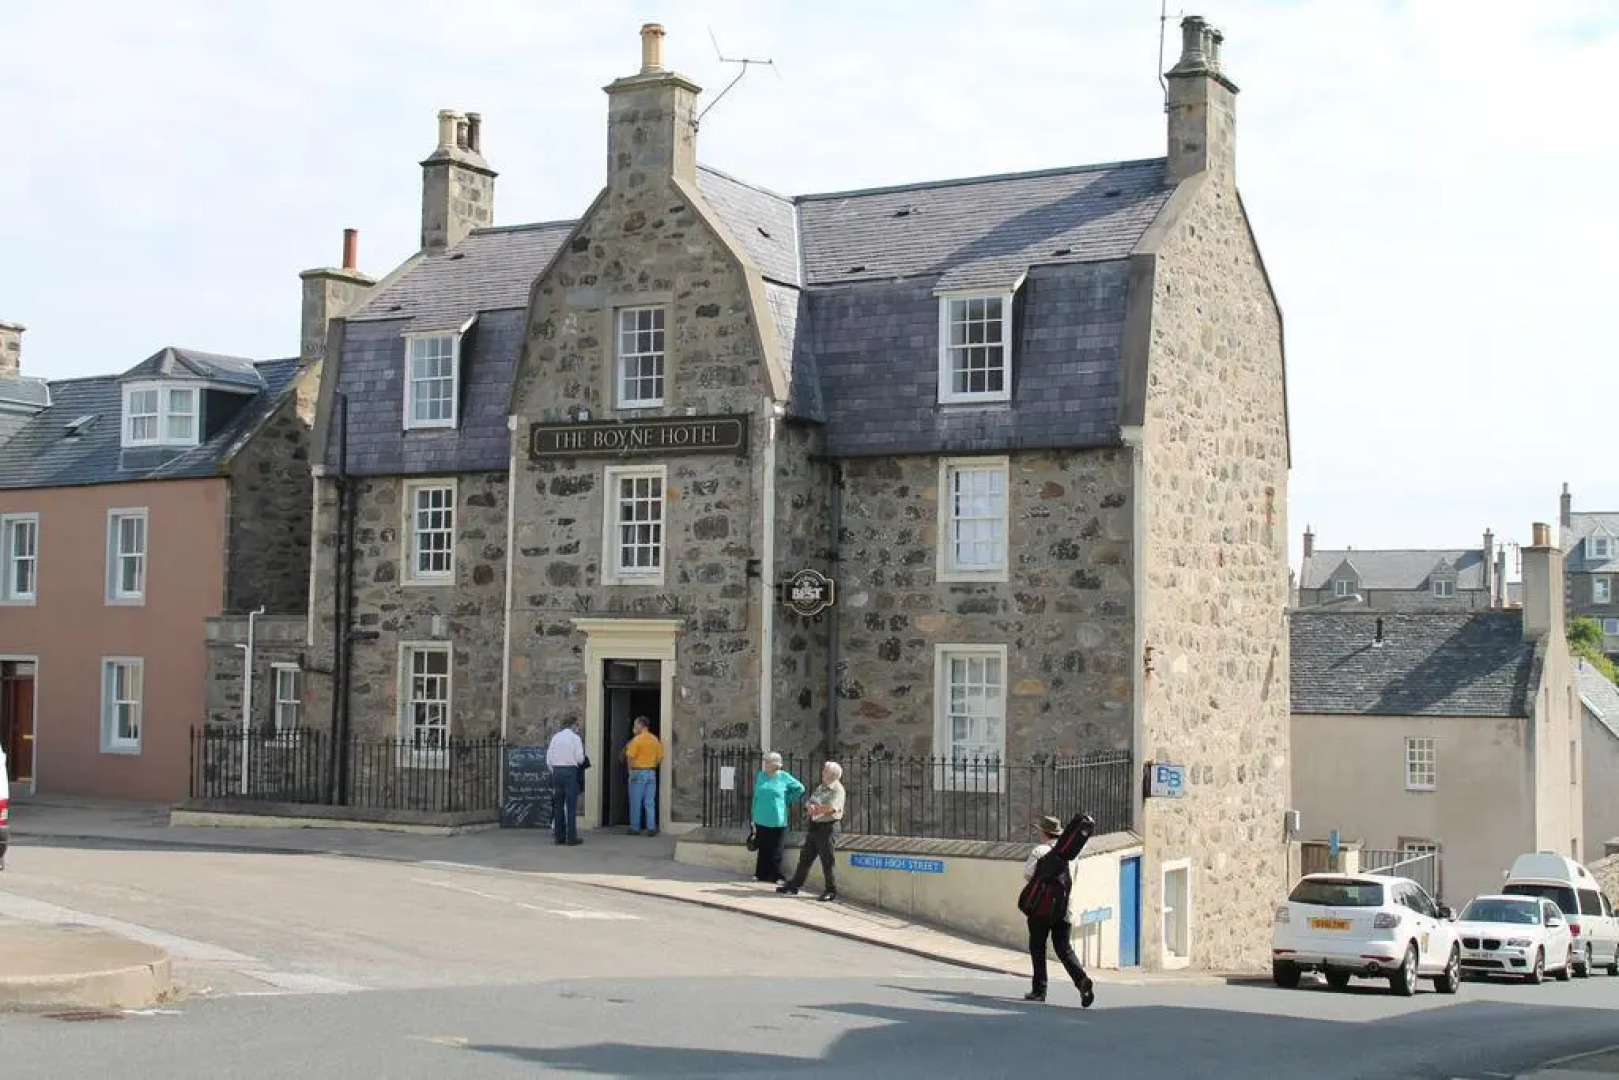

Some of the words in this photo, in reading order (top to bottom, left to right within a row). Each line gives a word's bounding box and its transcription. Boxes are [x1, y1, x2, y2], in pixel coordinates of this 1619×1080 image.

[555, 431, 586, 449] THE
[593, 428, 652, 447] BOYNE
[661, 425, 718, 444] HOTEL
[855, 856, 883, 867] NORTH
[885, 858, 905, 868] HIGH
[909, 860, 939, 871] STREET
